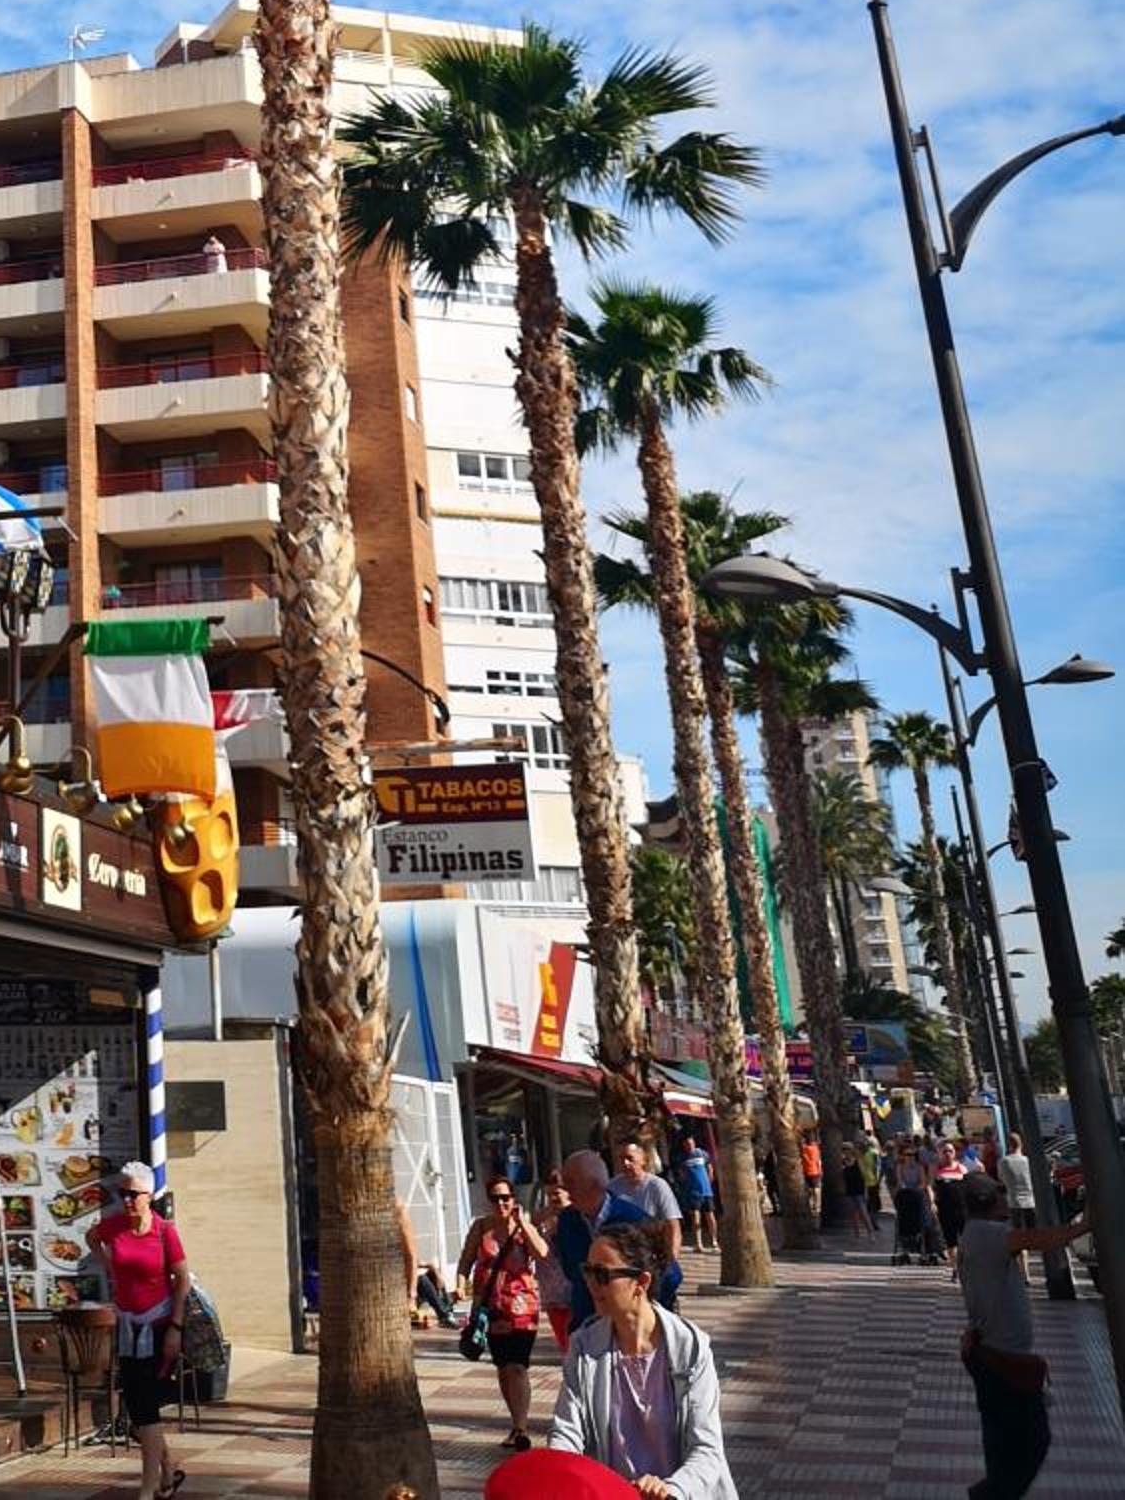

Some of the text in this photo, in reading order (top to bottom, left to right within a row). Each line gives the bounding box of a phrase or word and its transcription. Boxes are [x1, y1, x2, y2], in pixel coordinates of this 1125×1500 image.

[416, 778, 523, 799] TABACOS
[382, 828, 448, 844] Estanco
[387, 844, 524, 880] Filipinas
